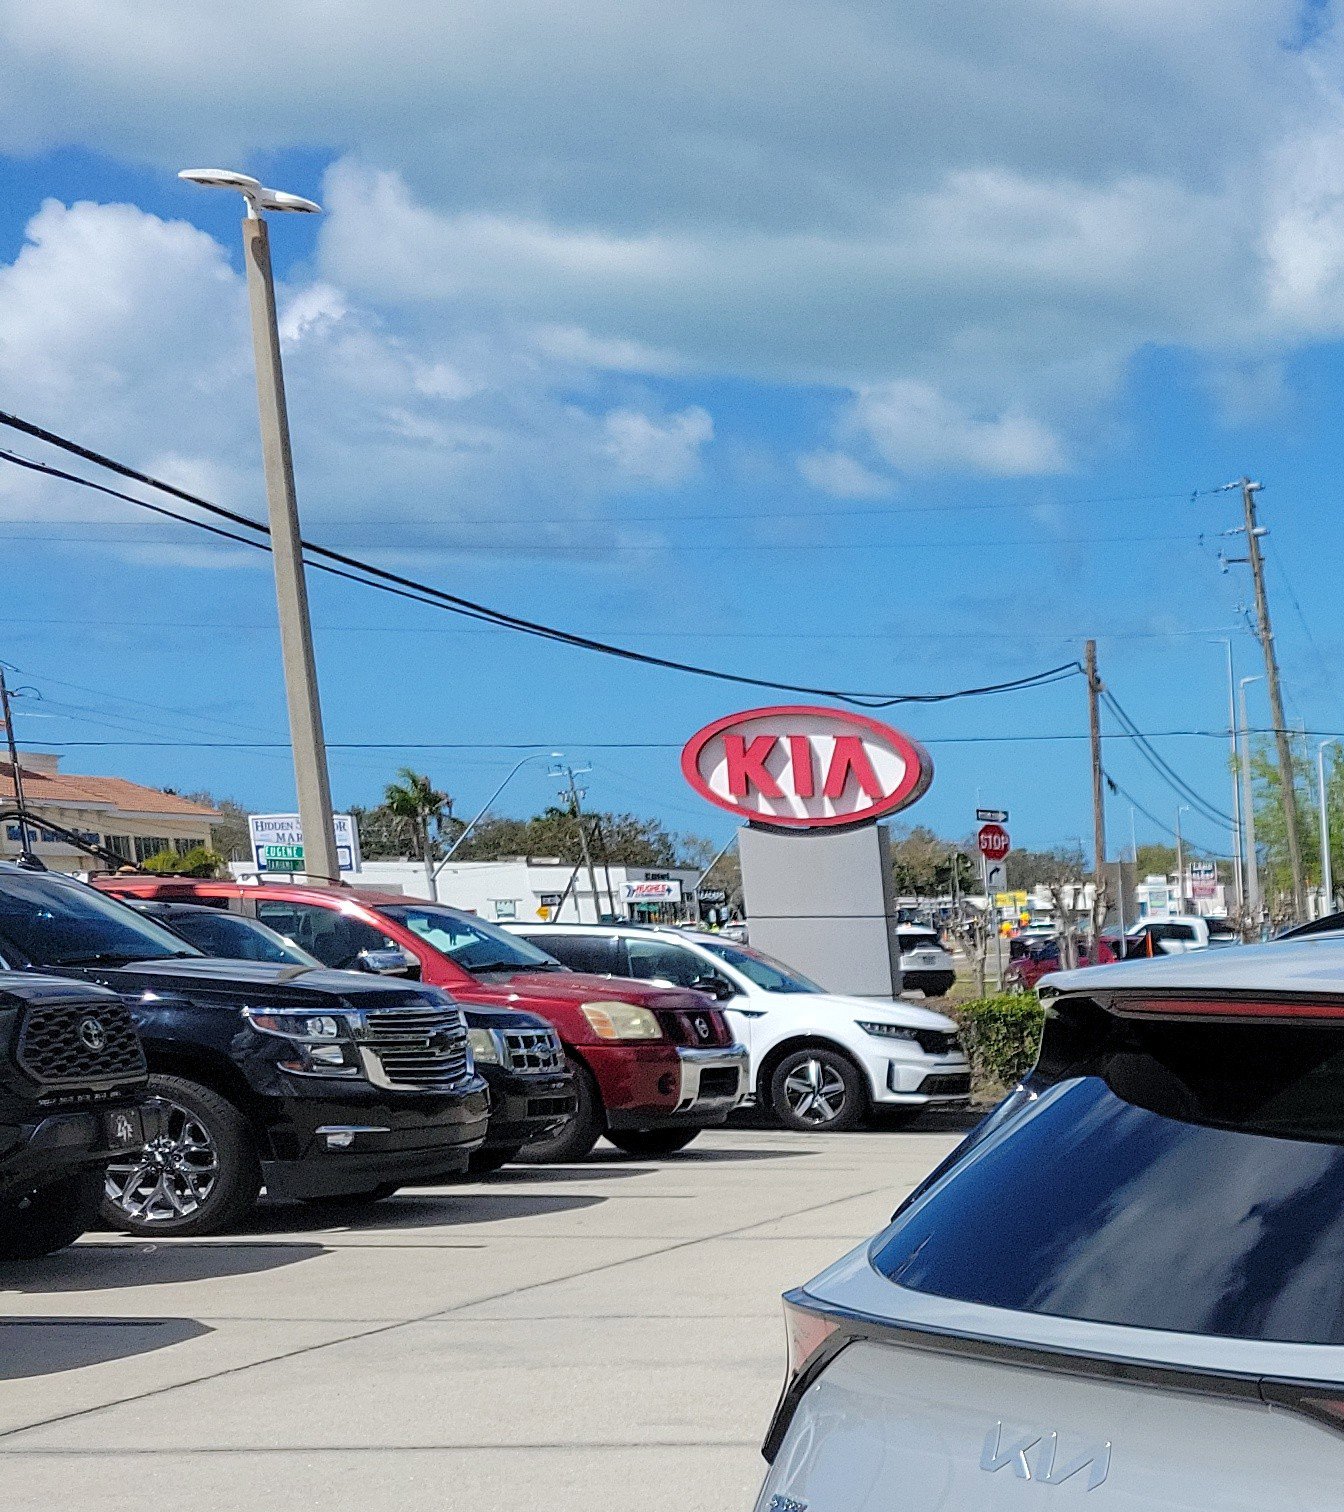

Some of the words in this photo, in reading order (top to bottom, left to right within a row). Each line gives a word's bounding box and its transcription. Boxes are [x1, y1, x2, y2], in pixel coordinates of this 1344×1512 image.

[723, 734, 885, 799] KIA
[255, 820, 293, 832] HIDDEN
[979, 834, 1009, 850] STOP
[265, 846, 298, 858] EUGENE
[980, 1420, 1112, 1491] KIA
